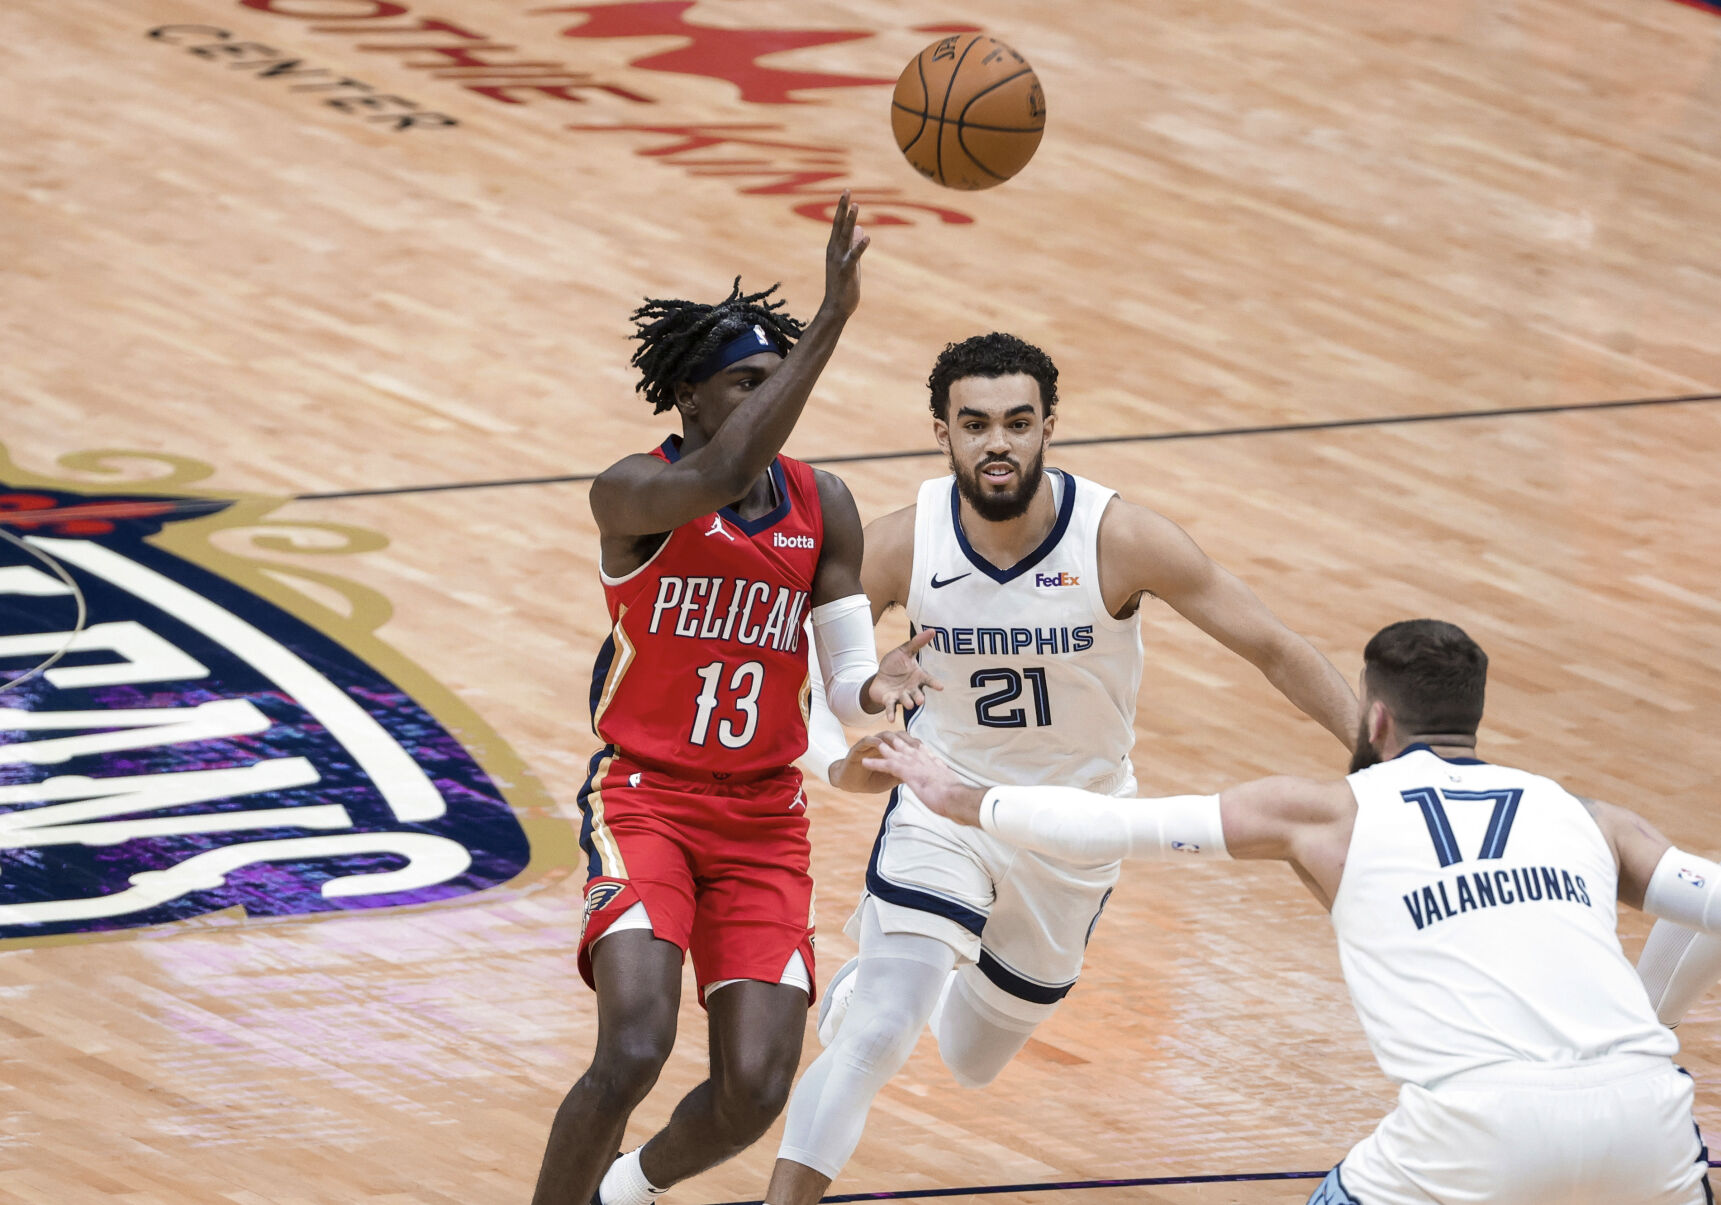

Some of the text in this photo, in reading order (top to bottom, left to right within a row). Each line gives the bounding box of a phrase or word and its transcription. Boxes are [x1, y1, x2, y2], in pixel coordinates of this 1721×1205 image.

[145, 23, 459, 131] CENTER
[773, 532, 815, 549] ibotta
[1035, 572, 1080, 588] FedEx
[688, 660, 765, 751] 13
[970, 666, 1052, 728] 21
[1400, 786, 1524, 868] 17
[1402, 865, 1593, 931] VALANCIUNAS
